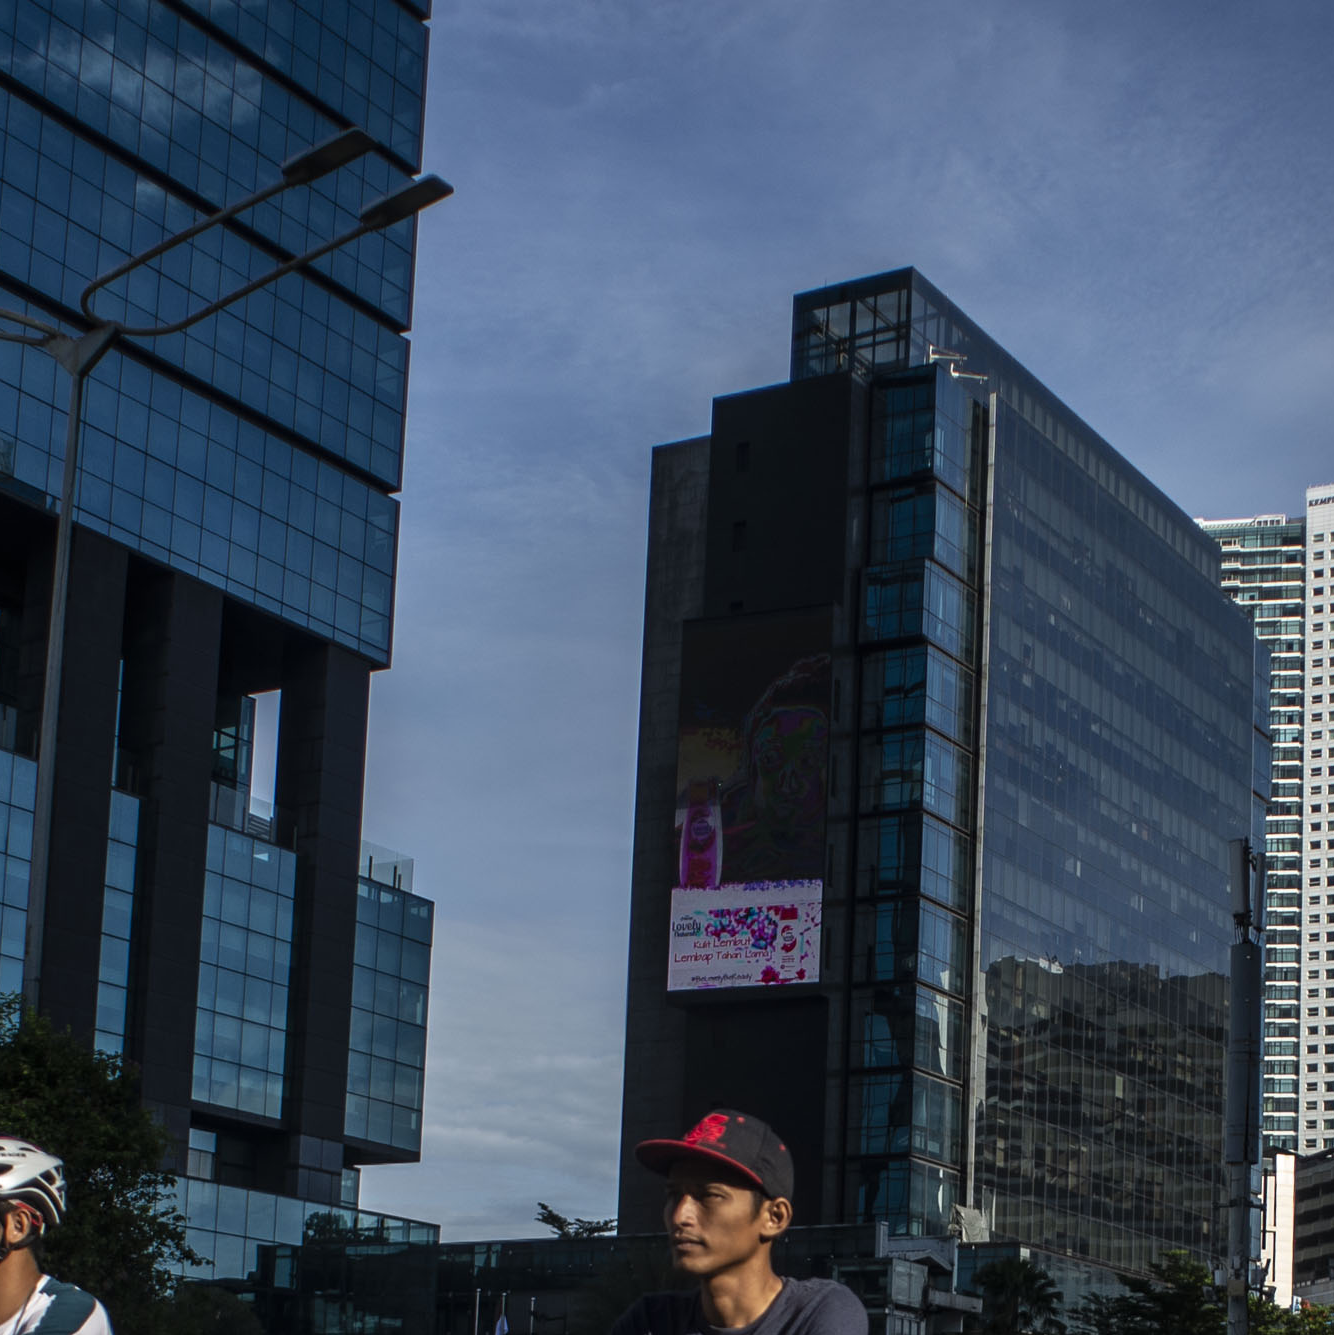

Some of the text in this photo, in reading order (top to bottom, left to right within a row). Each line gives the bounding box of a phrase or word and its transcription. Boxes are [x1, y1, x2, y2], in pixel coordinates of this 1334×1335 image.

[672, 919, 701, 933] Lovely
[693, 937, 752, 949] Kulit Lembut
[674, 952, 714, 965] Lembap
[717, 952, 742, 961] Tahan
